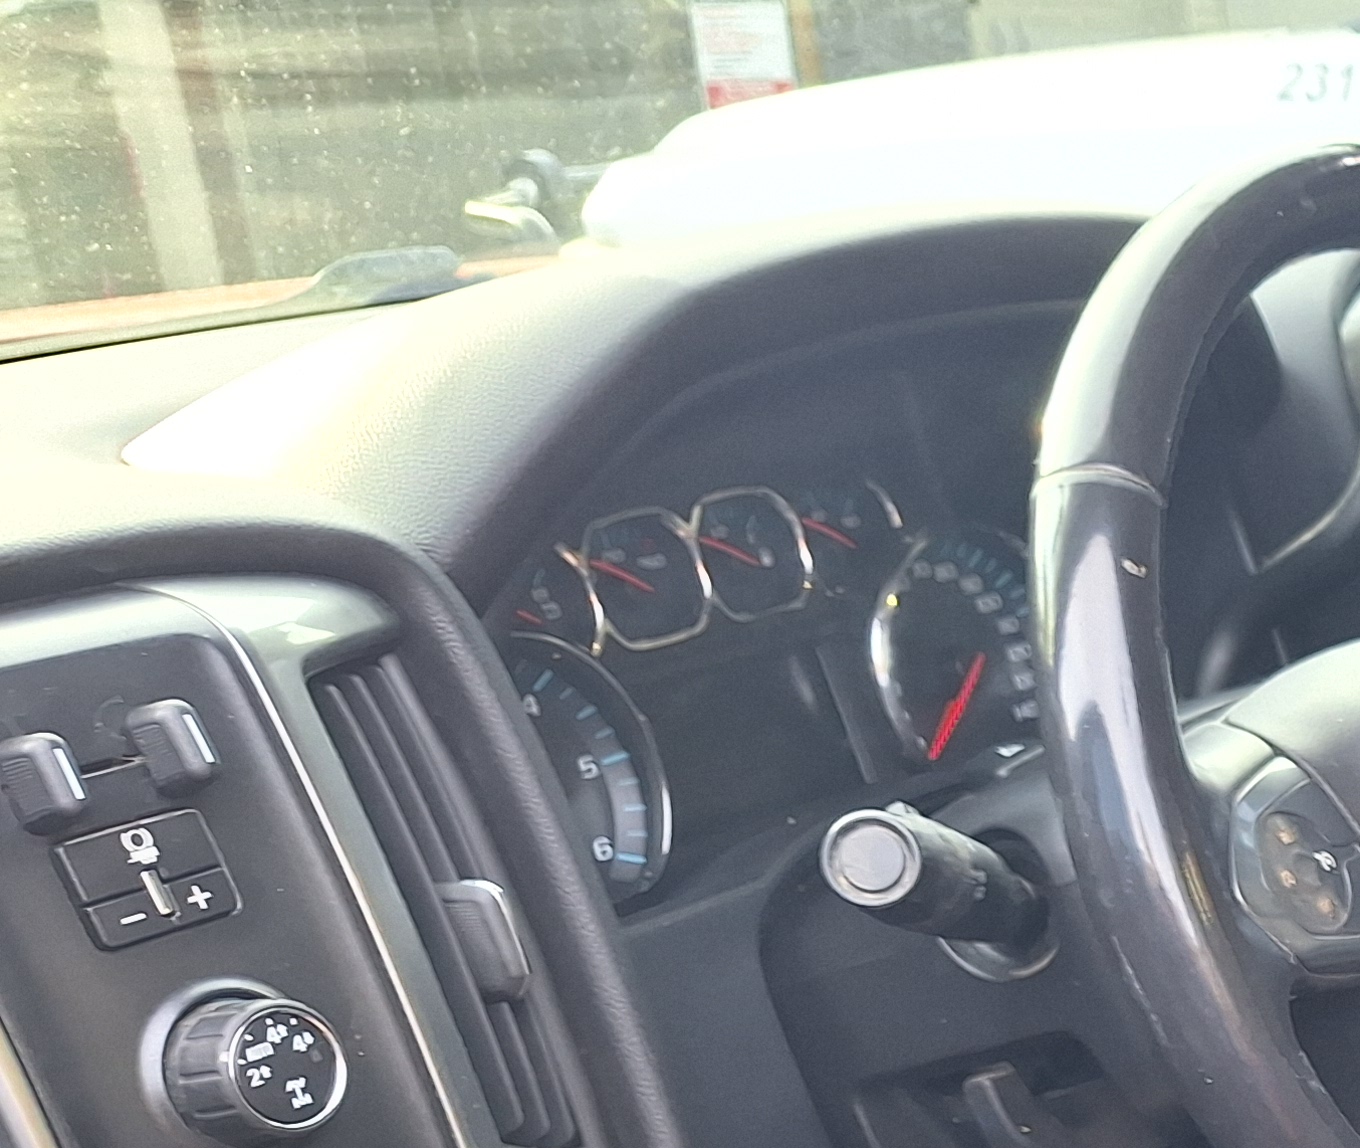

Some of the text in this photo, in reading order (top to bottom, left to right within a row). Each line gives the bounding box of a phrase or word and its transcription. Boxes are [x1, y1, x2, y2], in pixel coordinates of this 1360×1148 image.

[1278, 63, 1353, 101] 231
[576, 754, 599, 780] 5
[592, 835, 614, 862] 6
